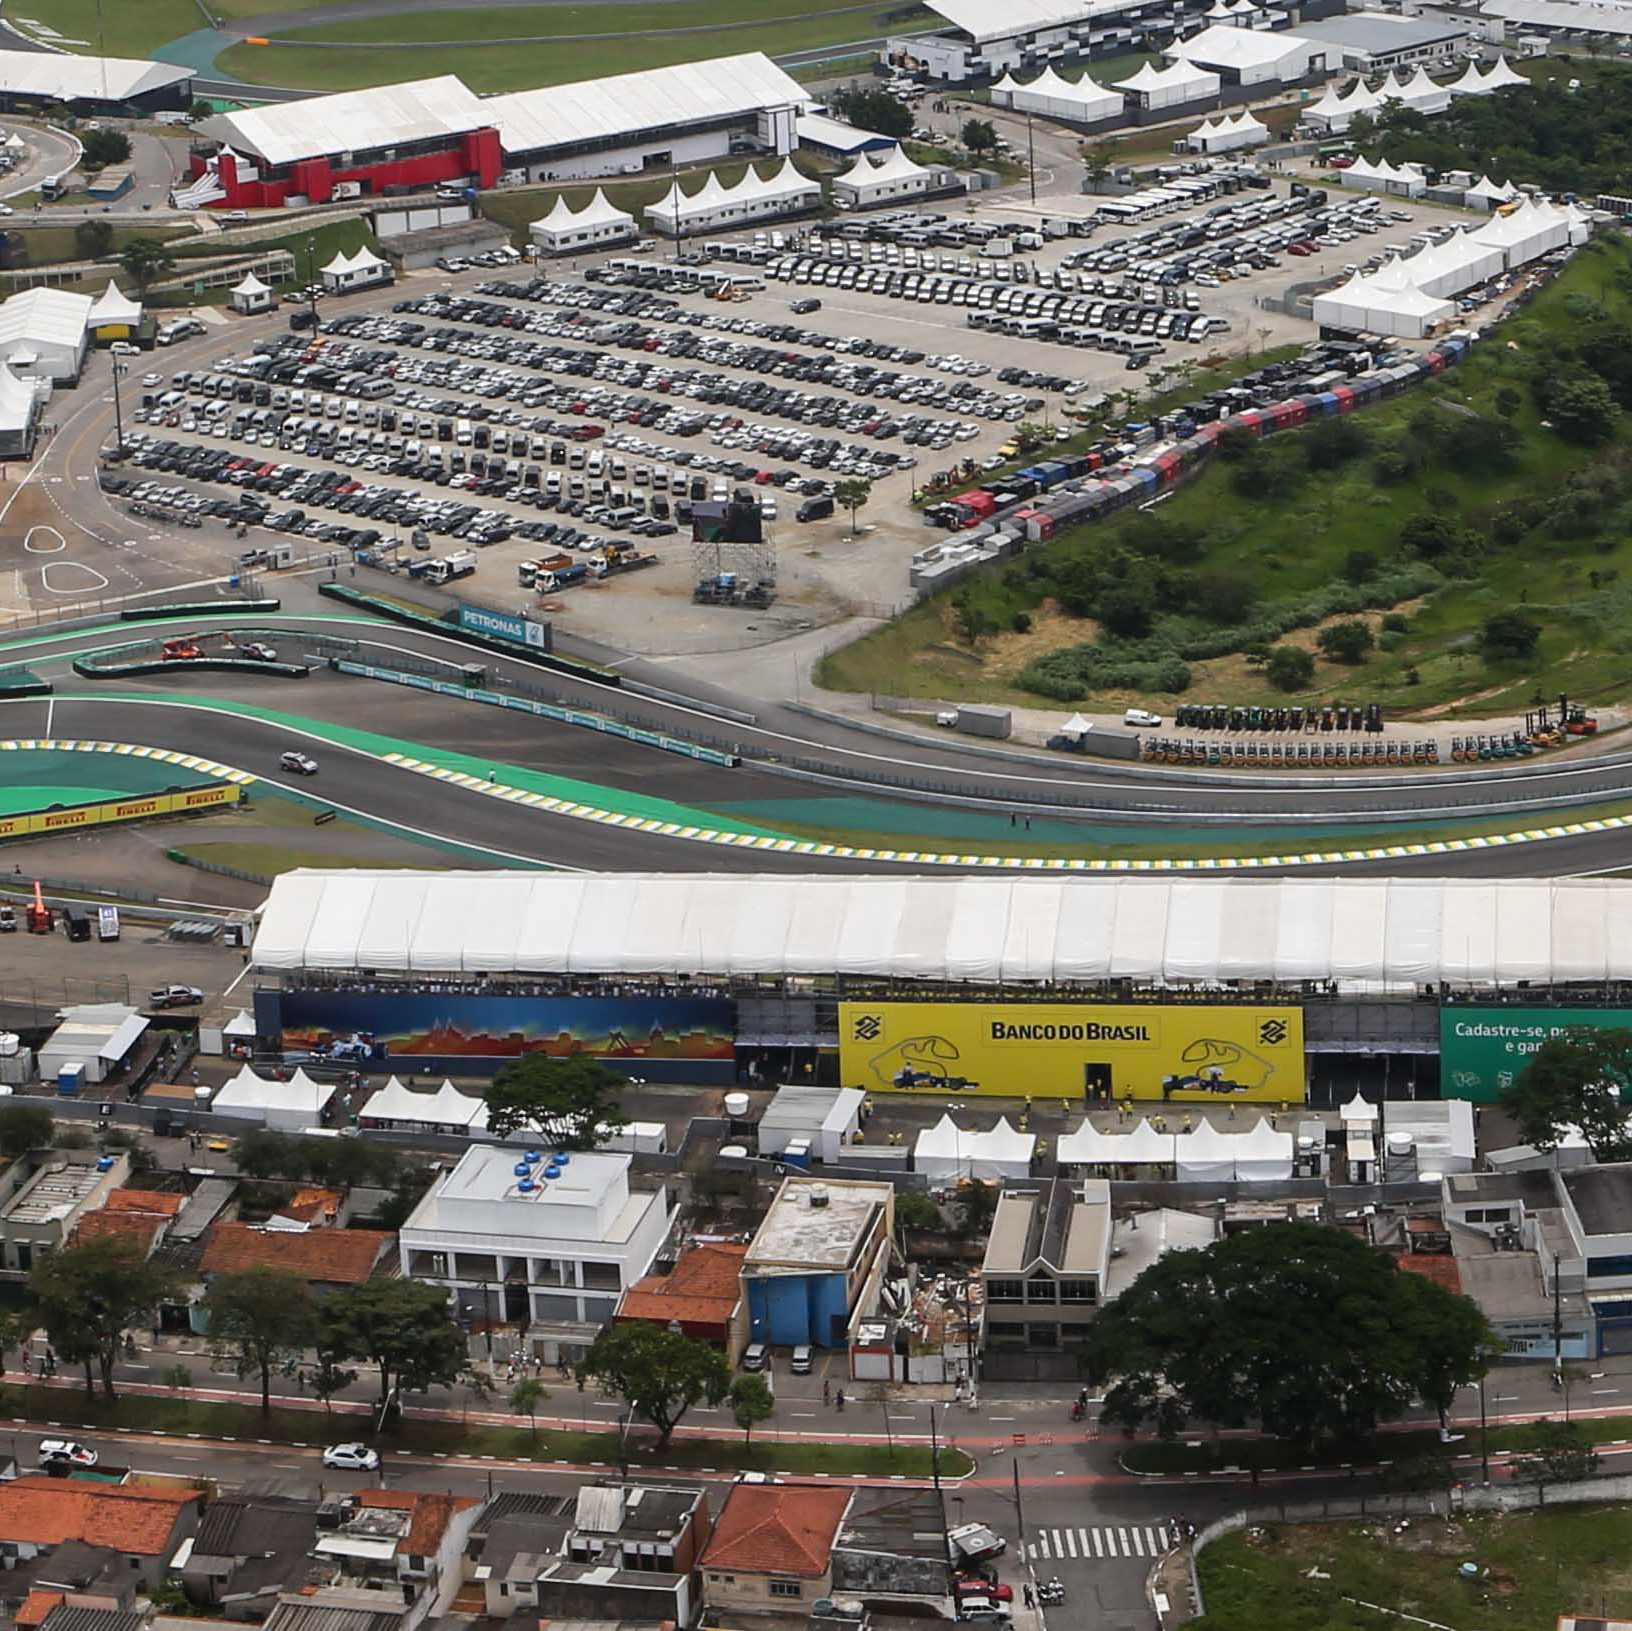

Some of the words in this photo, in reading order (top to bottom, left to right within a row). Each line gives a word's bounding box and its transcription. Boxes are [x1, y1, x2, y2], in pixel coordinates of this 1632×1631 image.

[463, 608, 522, 638] PETRONAS
[186, 790, 226, 806] PIRELLI
[117, 801, 156, 817] PIRELLI
[45, 811, 87, 828] PIRELLI
[991, 1021, 1057, 1040] BANCO
[1059, 1024, 1084, 1040] DO
[1086, 1022, 1151, 1041] BRASIL
[1455, 1022, 1547, 1039] Cadastre-se,
[1505, 1042, 1514, 1053] e
[101, 1105, 111, 1115] E
